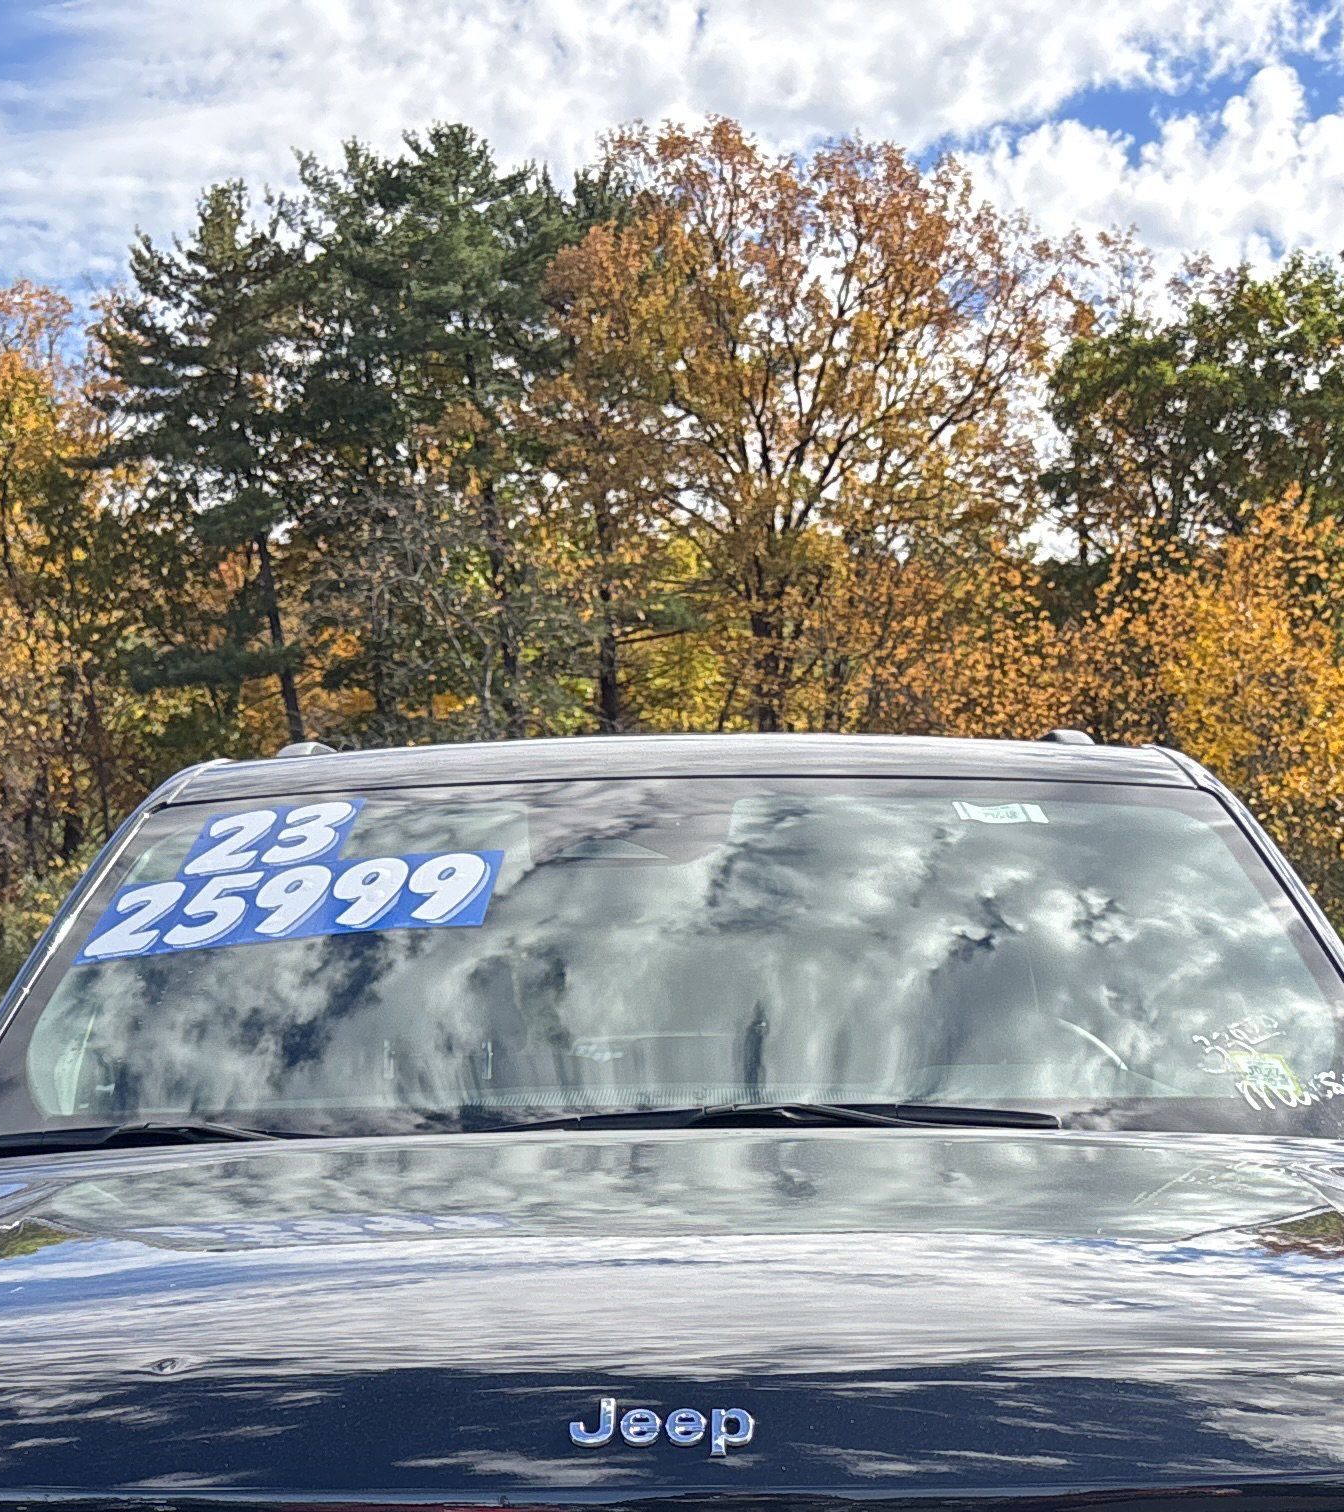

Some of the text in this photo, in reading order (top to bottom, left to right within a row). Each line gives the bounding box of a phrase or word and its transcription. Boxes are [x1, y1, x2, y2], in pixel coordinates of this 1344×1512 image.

[184, 802, 358, 876] 23
[84, 853, 490, 960] 25999
[569, 1397, 755, 1457] Jeep
